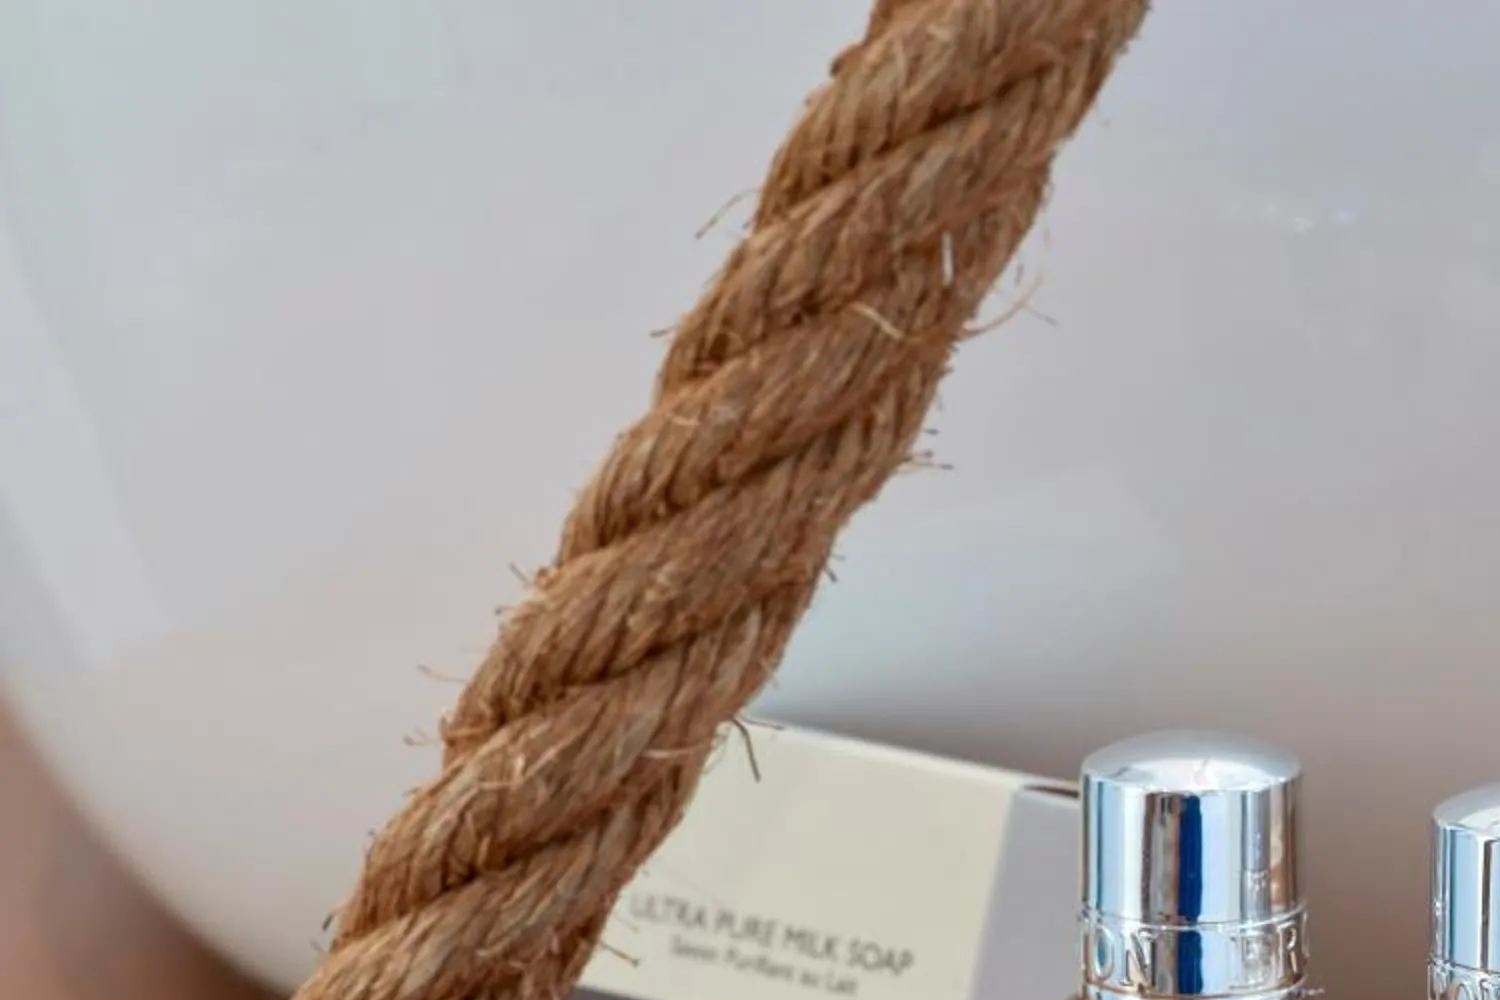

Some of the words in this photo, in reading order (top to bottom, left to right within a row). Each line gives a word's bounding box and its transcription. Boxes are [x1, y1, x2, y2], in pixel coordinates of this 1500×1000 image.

[630, 894, 706, 930] ULTRA
[715, 908, 777, 948] PURE
[783, 924, 839, 962] MILK
[847, 937, 915, 977] SOAP
